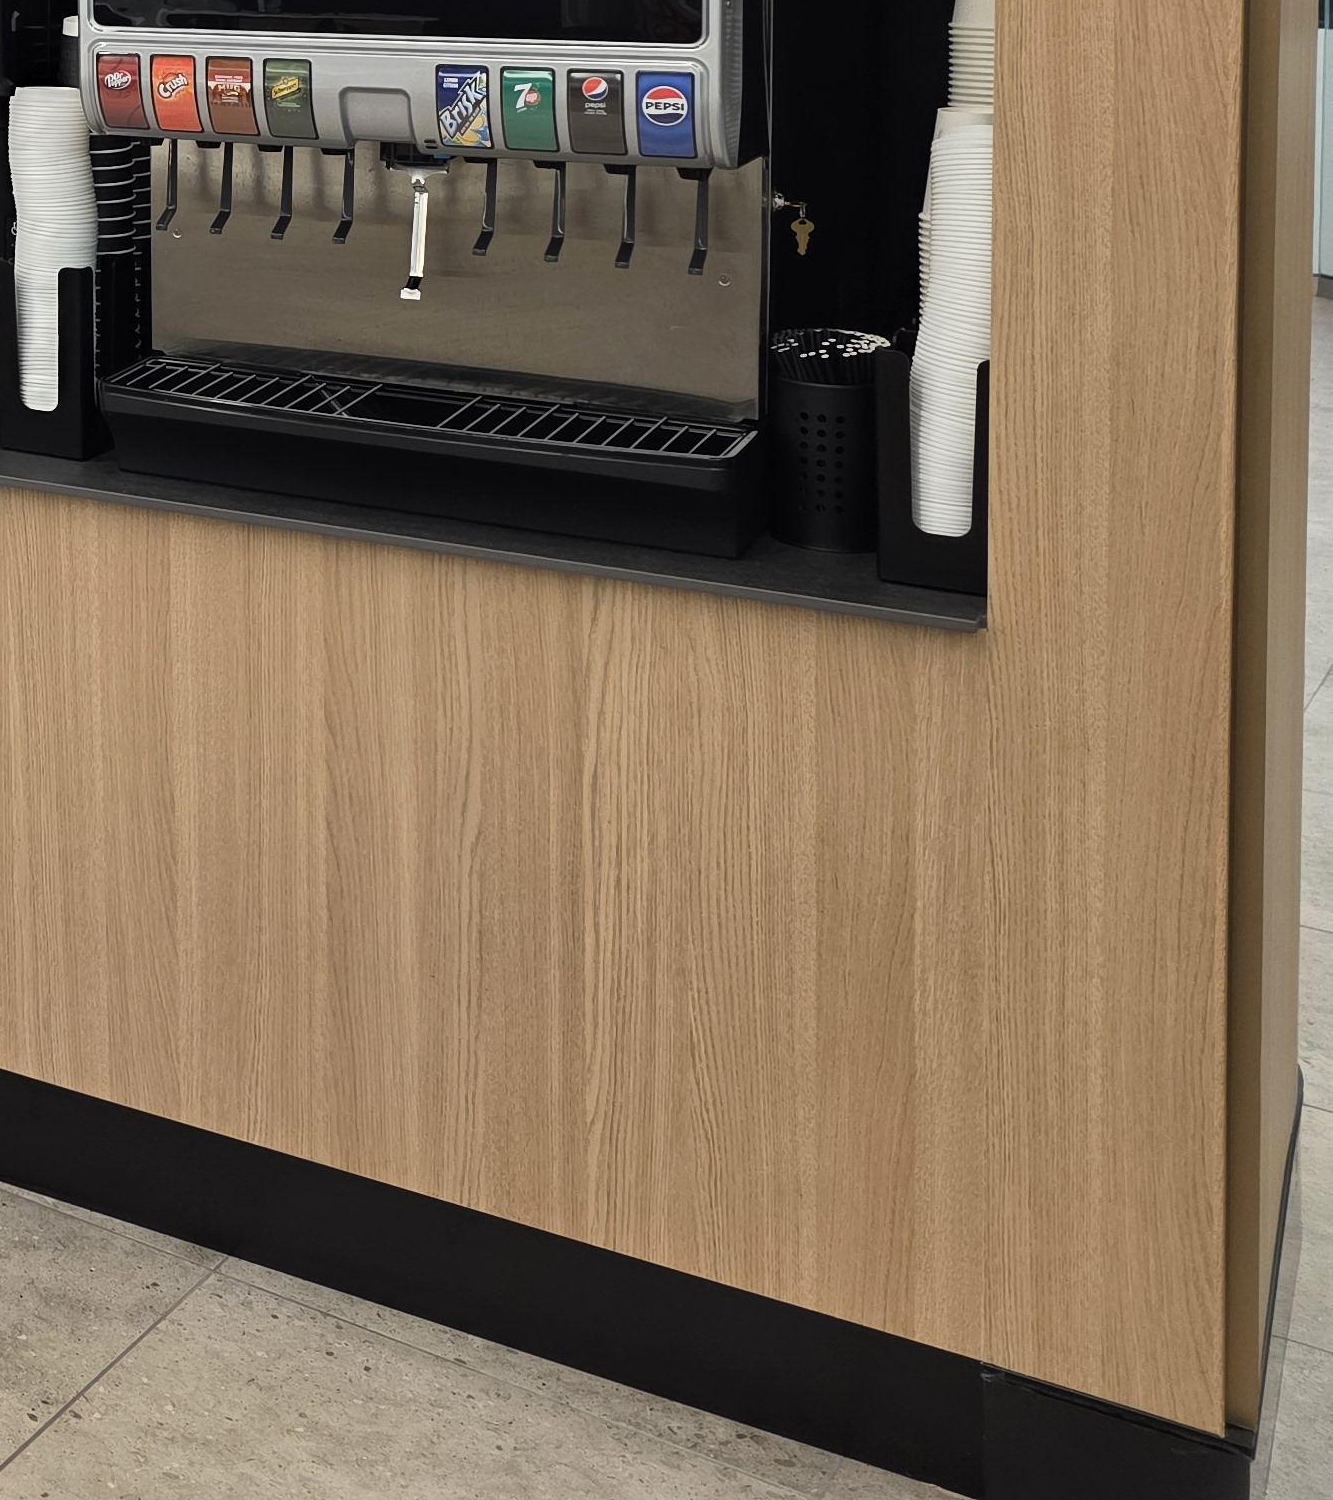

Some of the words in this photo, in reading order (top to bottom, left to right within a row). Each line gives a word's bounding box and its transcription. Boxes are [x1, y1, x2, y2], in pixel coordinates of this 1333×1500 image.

[158, 73, 188, 99] Crush
[584, 101, 607, 109] pepsi
[645, 101, 684, 111] PEPSI
